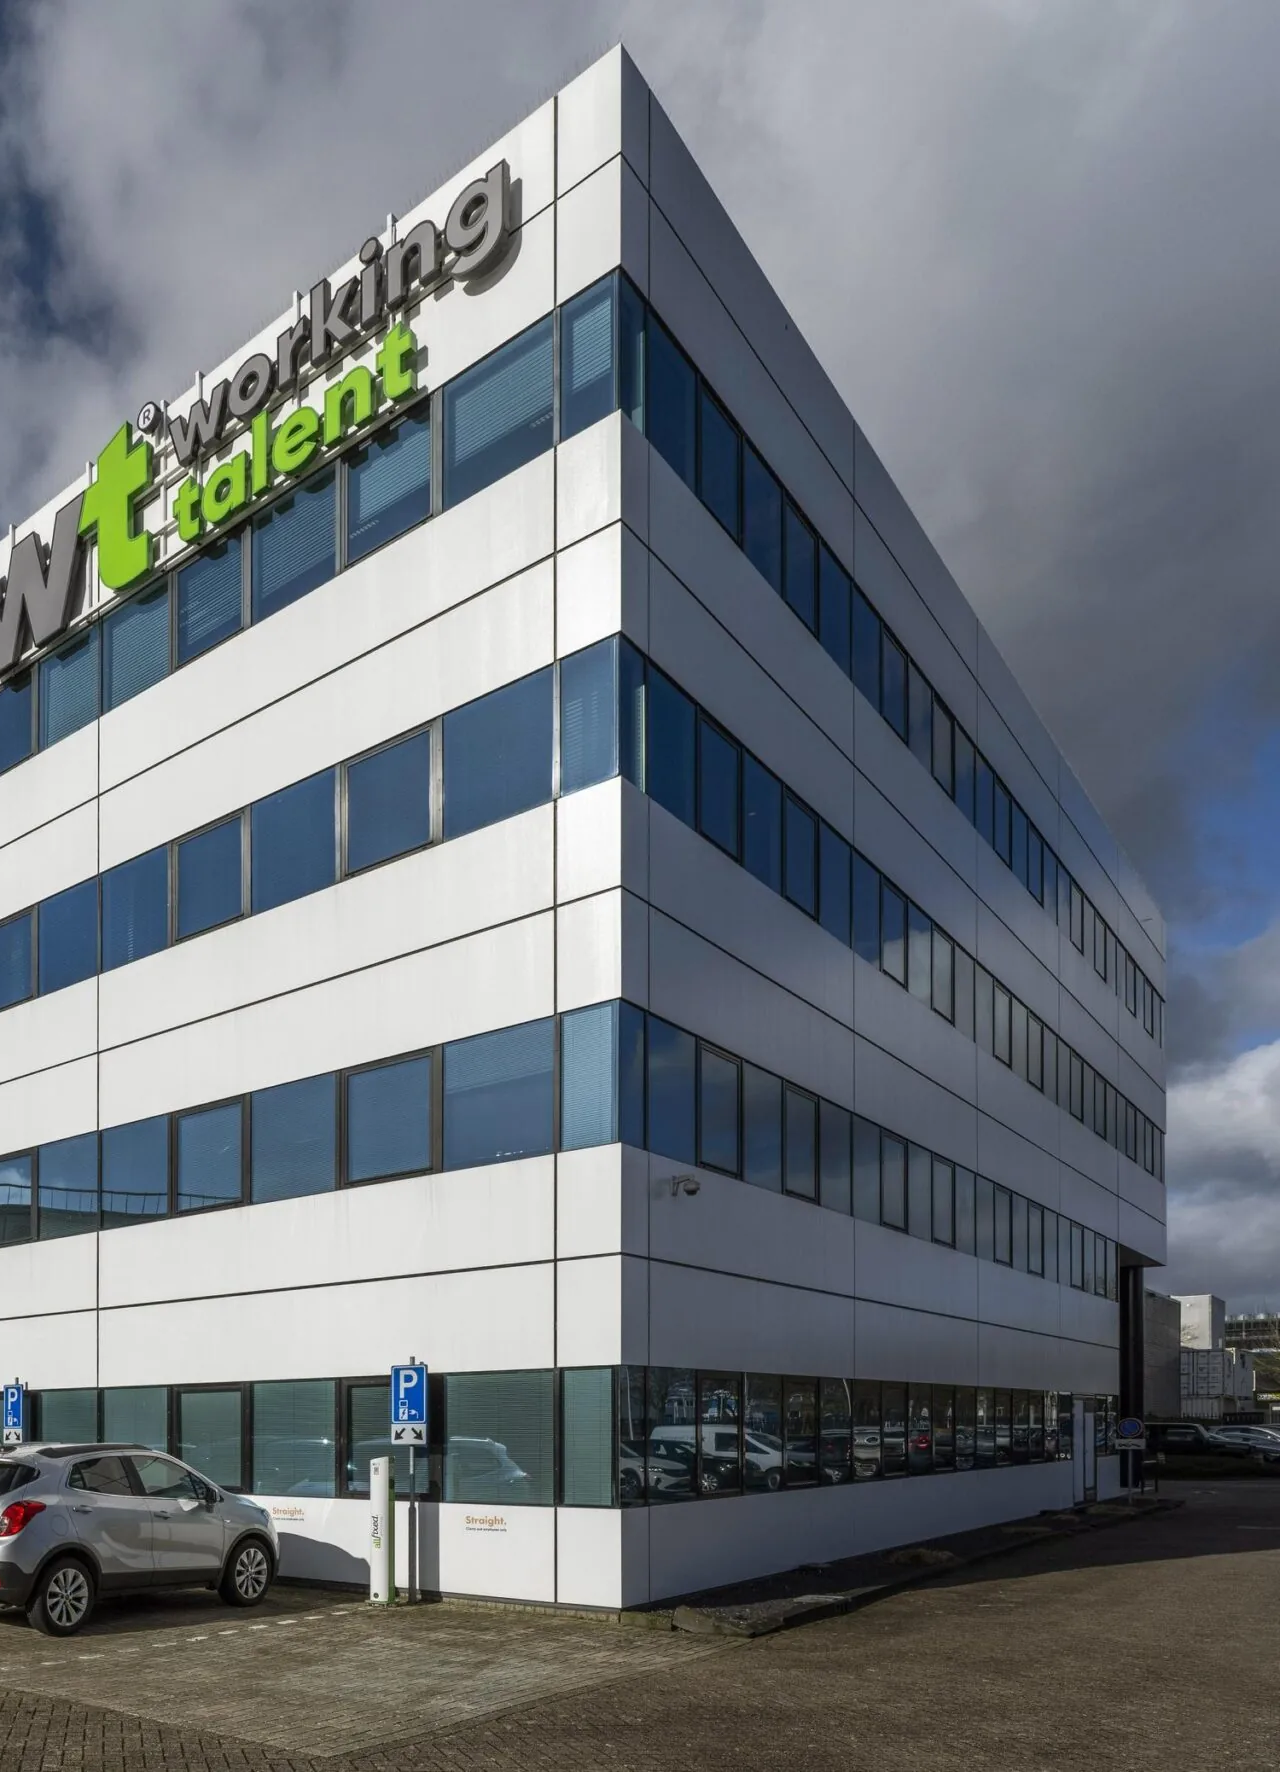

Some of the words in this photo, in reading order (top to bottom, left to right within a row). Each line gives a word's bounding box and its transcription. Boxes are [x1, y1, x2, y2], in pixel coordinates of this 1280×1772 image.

[167, 159, 512, 468] working
[172, 321, 420, 545] talent
[399, 1369, 418, 1399] P
[7, 1388, 18, 1410] P
[272, 1507, 305, 1518] Straight.
[465, 1515, 507, 1528] Straight.
